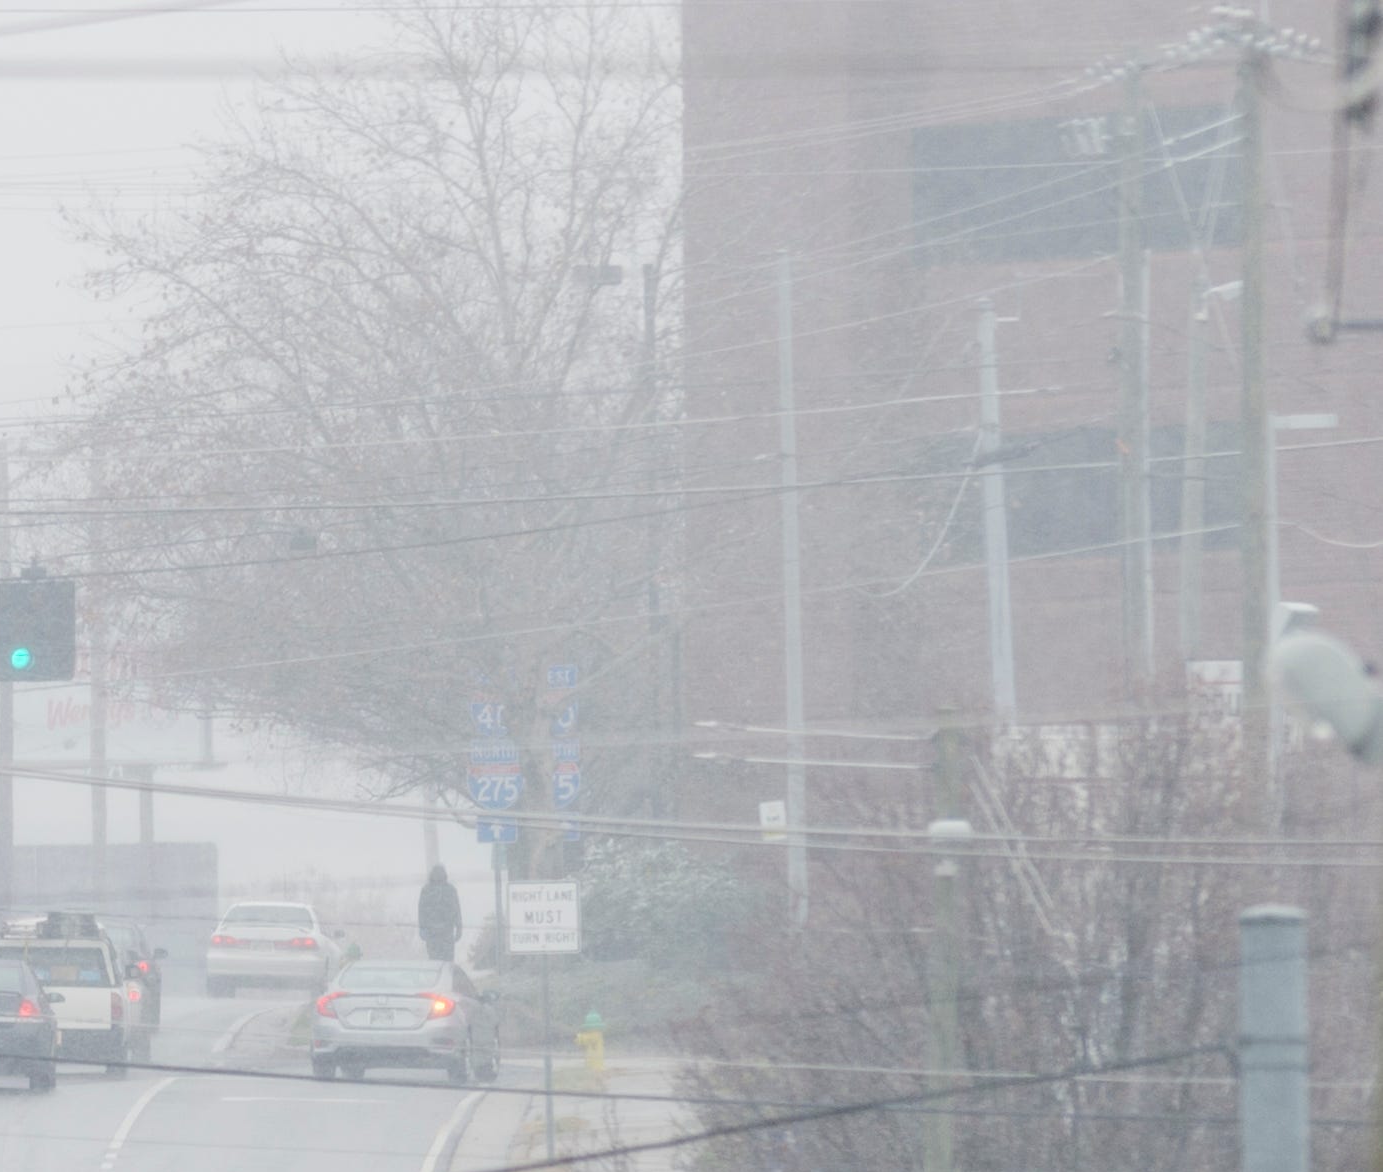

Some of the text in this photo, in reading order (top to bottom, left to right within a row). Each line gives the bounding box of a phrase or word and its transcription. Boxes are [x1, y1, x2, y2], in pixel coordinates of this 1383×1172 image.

[477, 776, 519, 802] 275
[512, 890, 574, 902] RIGHT LANE
[524, 909, 562, 924] MUST
[512, 931, 576, 944] TURN RIGHT
